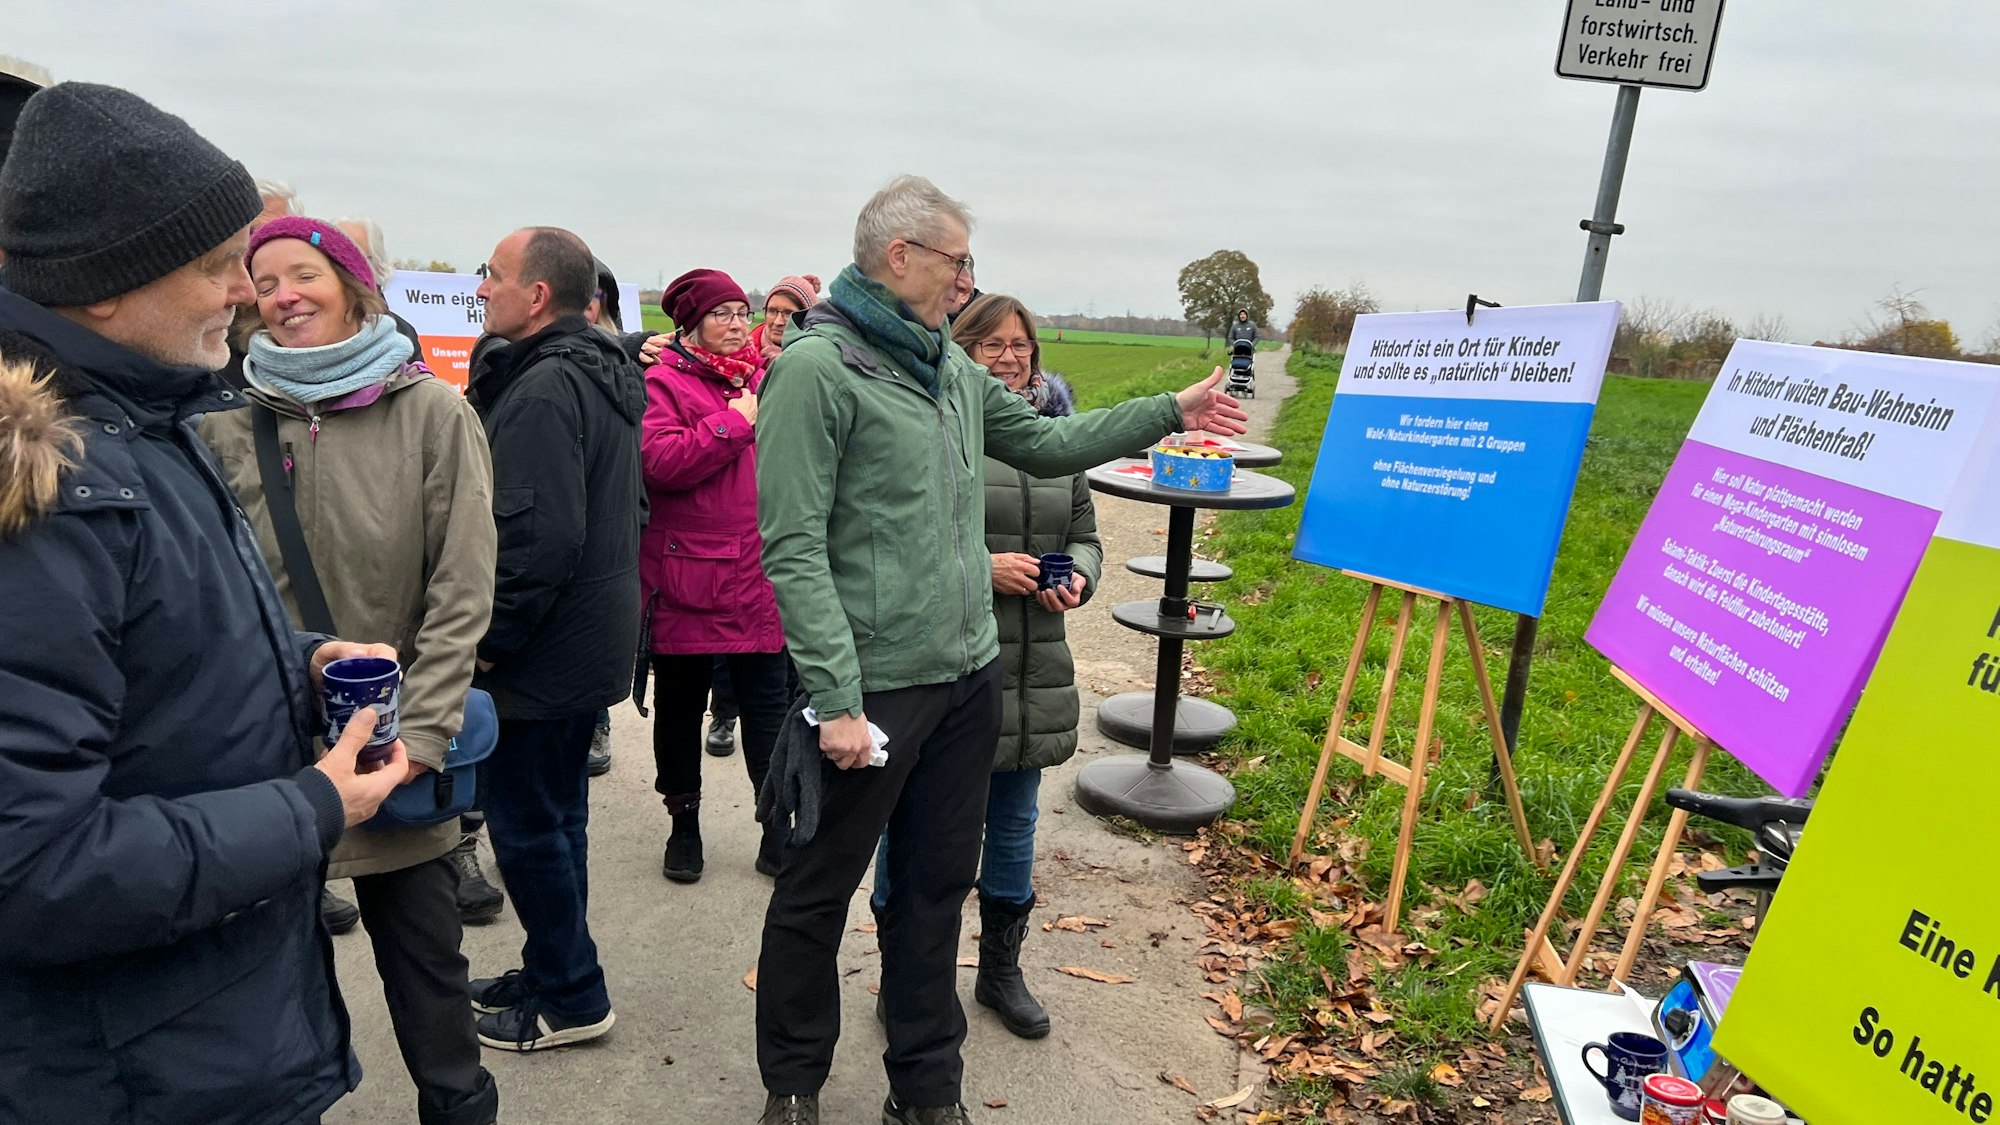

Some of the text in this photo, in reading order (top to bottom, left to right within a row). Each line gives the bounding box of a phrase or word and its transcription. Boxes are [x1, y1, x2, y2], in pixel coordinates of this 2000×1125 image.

[1581, 14, 1698, 44] forstwirtsch.
[1579, 43, 1693, 73] Verkehr frei
[405, 289, 446, 305] Wem
[431, 347, 468, 358] Unsere
[1370, 336, 1561, 357] Hitdorf ist ein Ort für Kinder
[1353, 361, 1576, 385] und sollte es „natürlich“ bleiben!
[1727, 368, 1955, 431] In Hitdorf wüten Bau-Wahnsinn
[1365, 427, 1526, 453] Wald-/Naturkindergarten mit 2 Gruppen
[1400, 414, 1490, 431] Wir fordern hier einen
[1749, 413, 1876, 461] und Flächenfraß!
[1373, 459, 1497, 485] ohne Flächenversiegelung und
[1381, 475, 1472, 501] ohne Naturzerstörung!
[1712, 467, 1864, 531] Hier soll Natur plattgemacht werden
[1691, 482, 1869, 562] für einen Mega-Kindergarten mit sinnlosem
[1663, 562, 1807, 649] danach wird die Feldflur zubetoniert!
[1706, 559, 1736, 585] Zuerst
[1732, 572, 1749, 591] die
[1746, 577, 1829, 637] Kindertagesstätte,
[1635, 594, 1790, 703] Wir müssen unsere Naturflächen schützen
[1669, 645, 1722, 687] und erhalten!
[1899, 908, 1975, 979] Eine
[1853, 1006, 1993, 1124] So hatte
